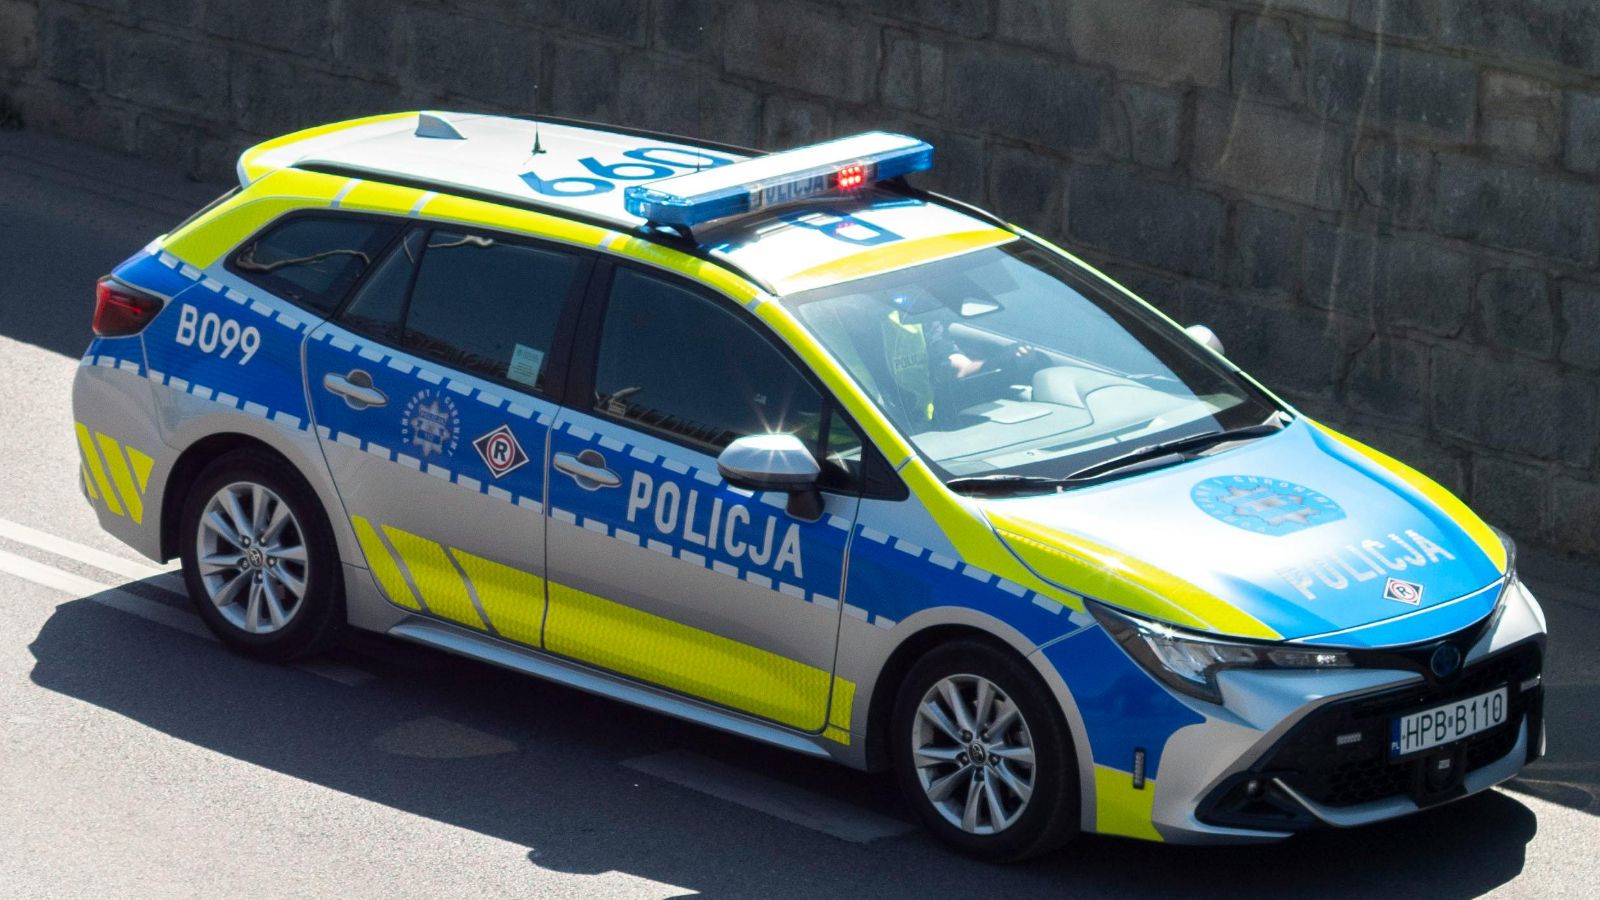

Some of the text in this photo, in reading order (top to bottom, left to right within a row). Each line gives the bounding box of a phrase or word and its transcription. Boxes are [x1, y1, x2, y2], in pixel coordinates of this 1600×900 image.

[176, 303, 261, 366] B099
[494, 441, 508, 462] R
[626, 470, 804, 579] POLICJA
[1275, 529, 1456, 601] POLICJA
[1395, 585, 1411, 598] R
[1391, 742, 1400, 751] PL
[1406, 710, 1447, 750] HPB
